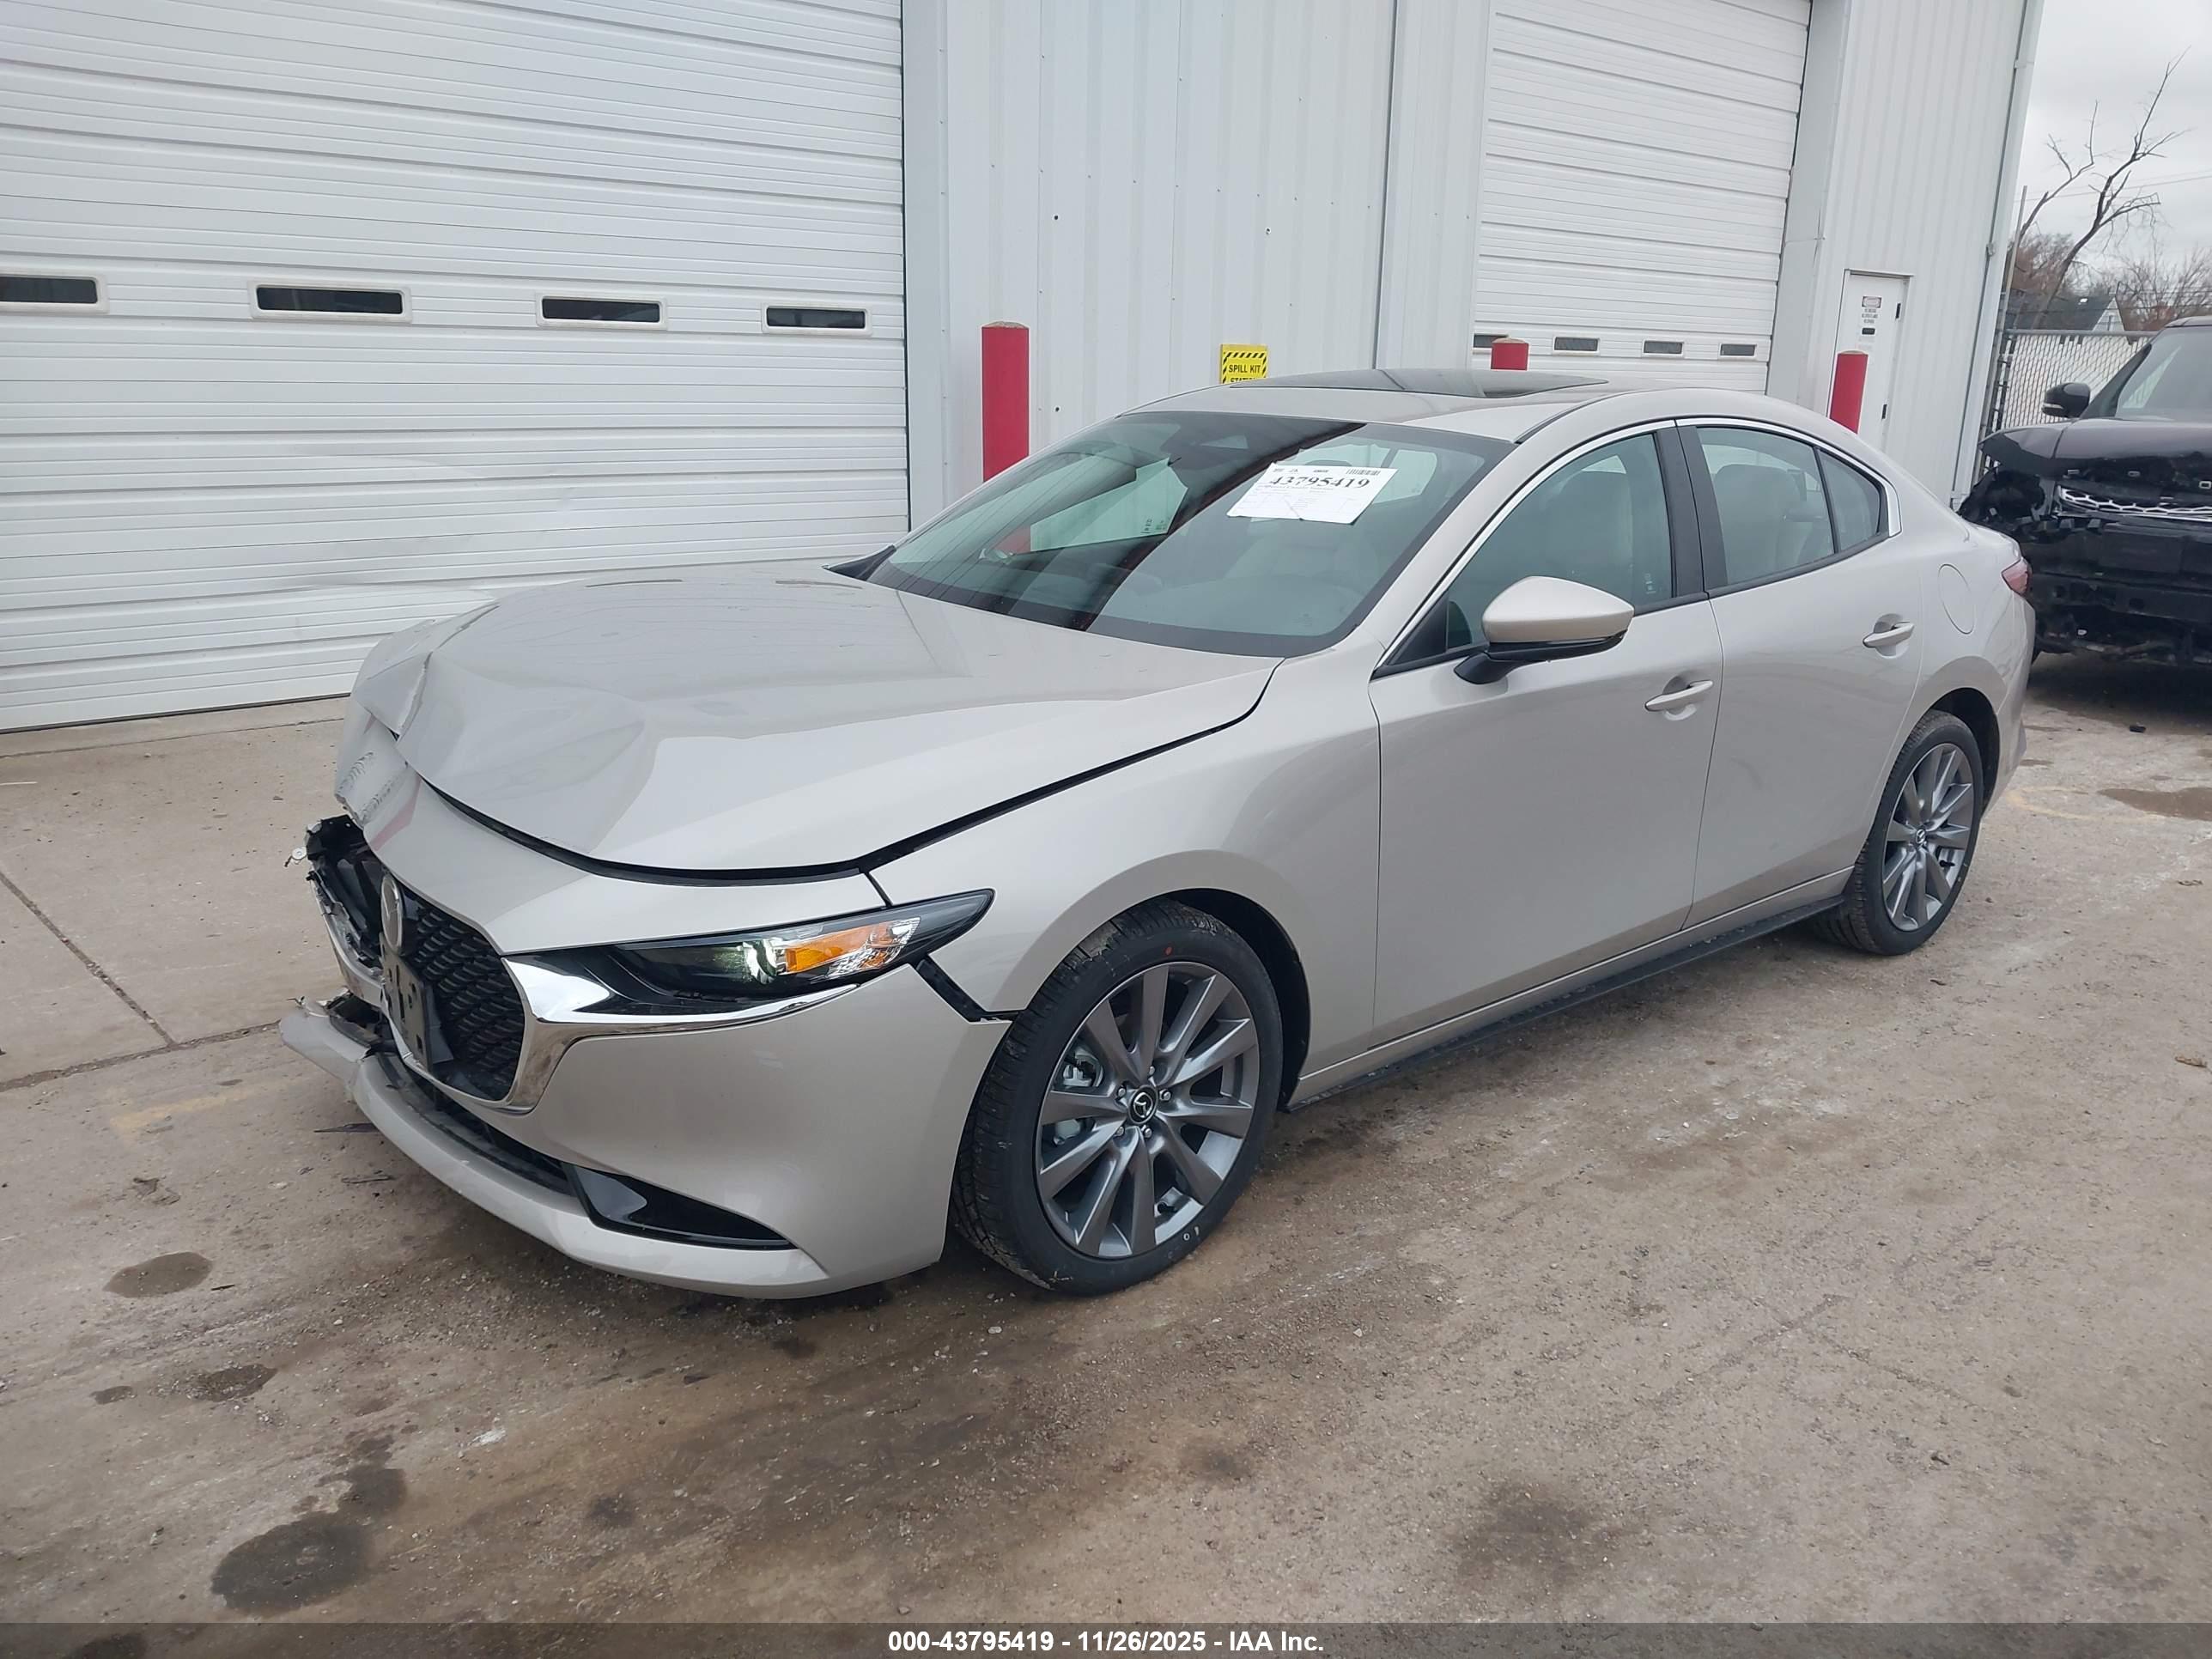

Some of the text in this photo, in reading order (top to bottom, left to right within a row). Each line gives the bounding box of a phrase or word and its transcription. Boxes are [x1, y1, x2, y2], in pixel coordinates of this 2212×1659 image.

[1229, 364, 1261, 374] SPILL KIT
[1270, 476, 1370, 489] 43795419
